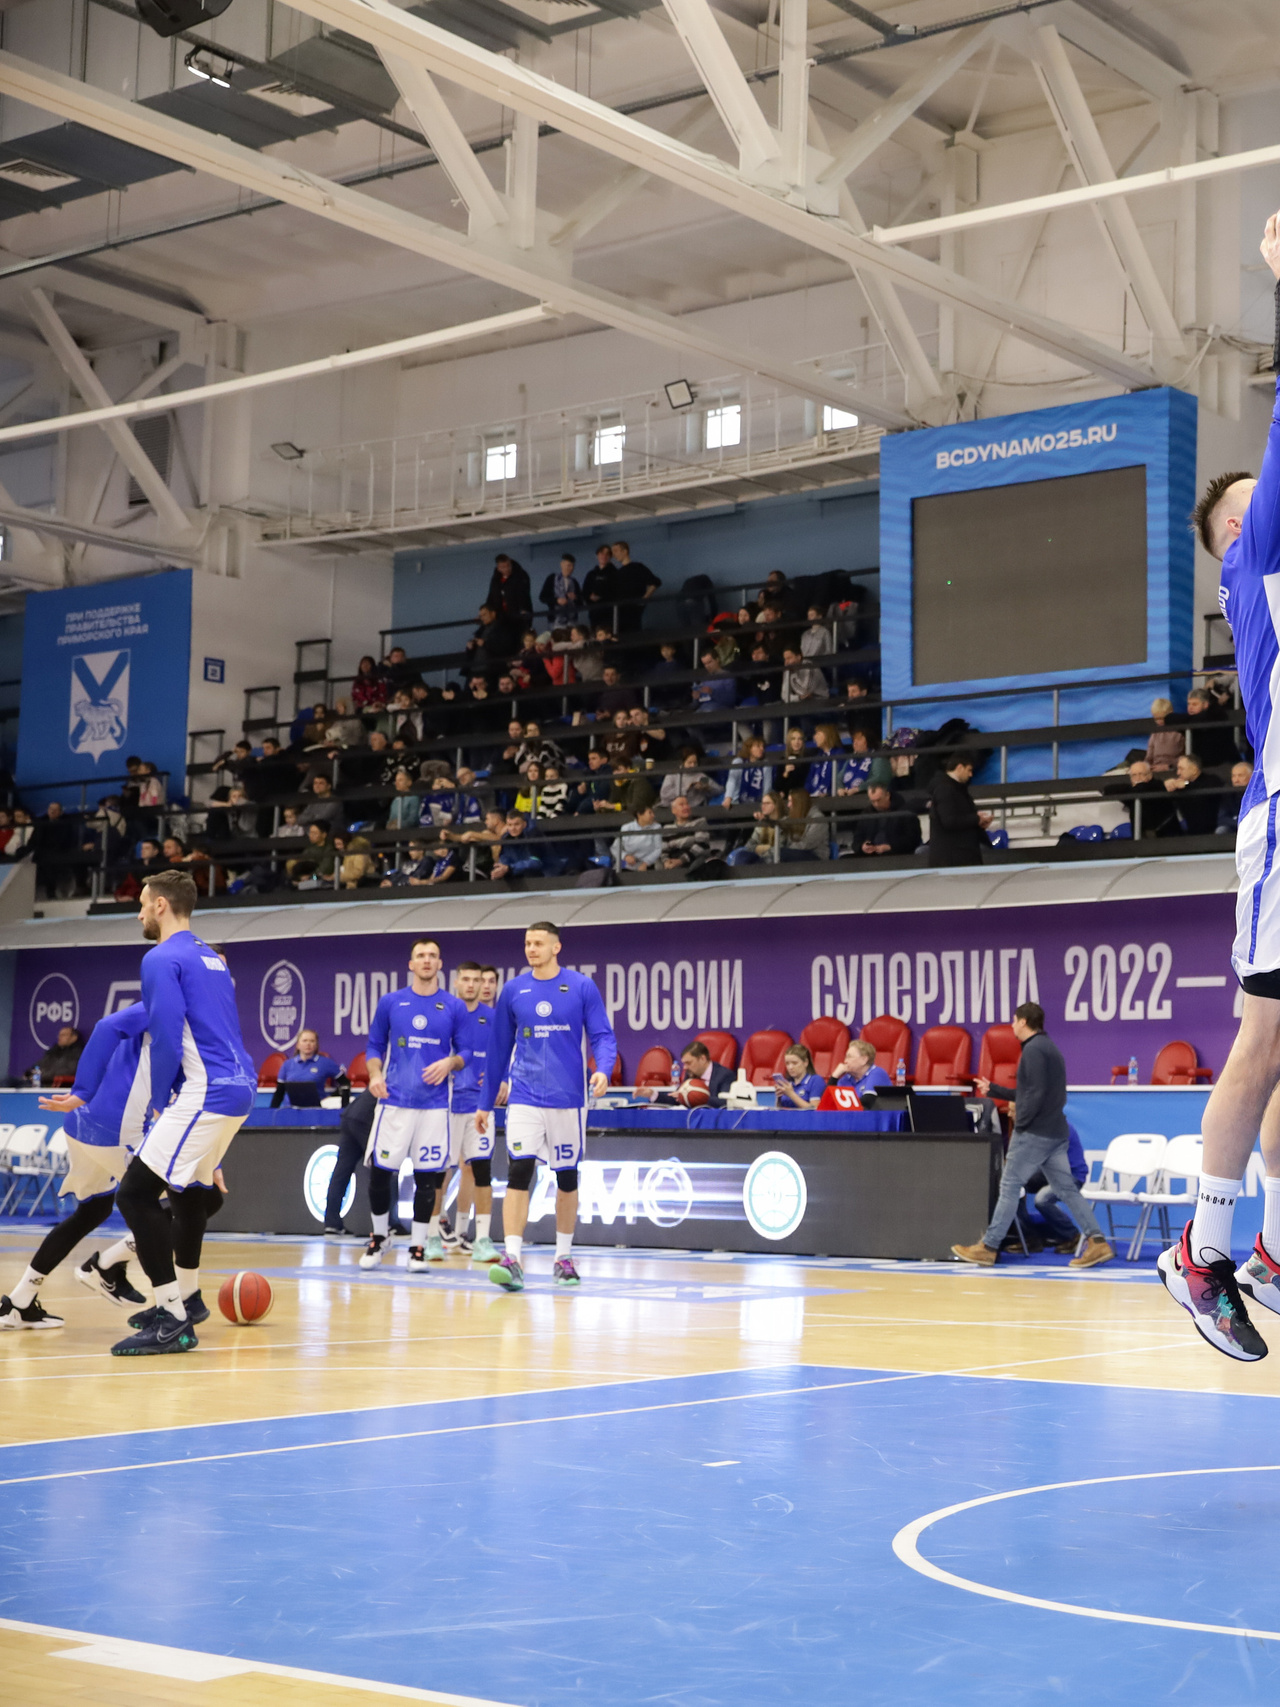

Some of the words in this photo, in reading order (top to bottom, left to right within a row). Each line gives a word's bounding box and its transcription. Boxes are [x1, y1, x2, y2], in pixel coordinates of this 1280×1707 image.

[936, 423, 1117, 469] BCDYNAMO25.RU
[606, 959, 743, 1031] РОССИИ
[811, 948, 1039, 1027] СУПЕРЛИГА
[36, 1001, 73, 1022] РФБ
[478, 1137, 490, 1151] 3
[554, 1144, 574, 1161] 15
[419, 1146, 441, 1162] 25
